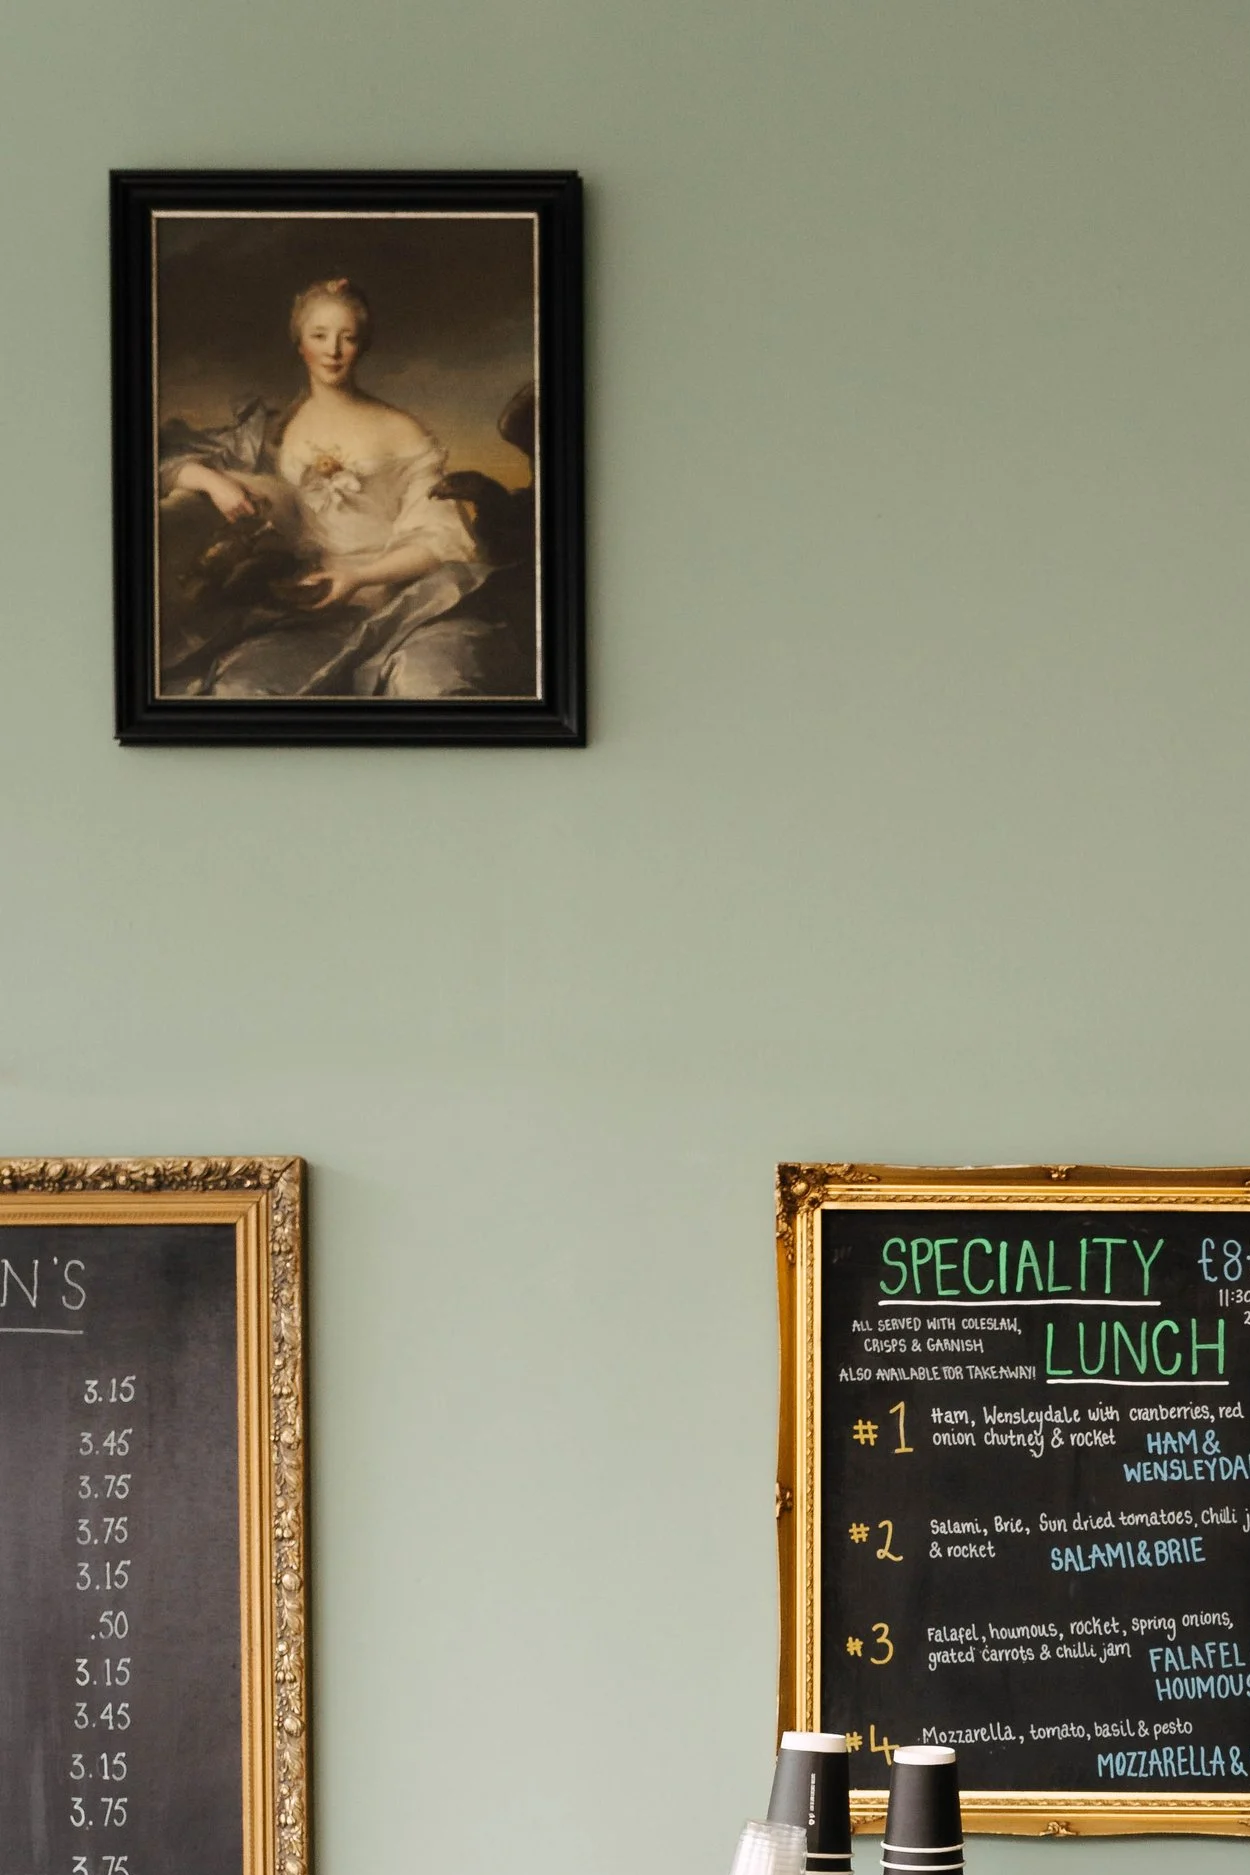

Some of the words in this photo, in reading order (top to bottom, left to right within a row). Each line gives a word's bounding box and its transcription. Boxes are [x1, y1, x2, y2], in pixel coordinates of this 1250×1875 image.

[879, 1238, 1164, 1295] SPECIALITY
[852, 1320, 872, 1332] ALL
[878, 1318, 921, 1332] SERVED
[927, 1318, 955, 1331] WITH
[864, 1338, 906, 1353] CRISPS
[911, 1339, 922, 1352] &
[926, 1338, 984, 1353] GARNISH
[1046, 1318, 1226, 1376] LUNCH
[839, 1368, 872, 1382] ALSO
[876, 1366, 938, 1381] AVAILABLE
[943, 1366, 963, 1380] FOR
[84, 1375, 136, 1403] 3.15
[983, 1404, 1081, 1436] Wensleydale
[1088, 1402, 1120, 1422] with
[1219, 1402, 1245, 1419] red
[79, 1428, 133, 1456] 3.45
[932, 1429, 976, 1447] onion
[984, 1428, 1044, 1458] chutney
[1051, 1429, 1064, 1448] &
[1070, 1428, 1116, 1447] rocket
[1147, 1429, 1198, 1455] HAM
[78, 1474, 131, 1500] 3.75
[76, 1517, 128, 1545] 3.75
[1039, 1513, 1067, 1533] Sun
[1072, 1511, 1114, 1531] dried
[929, 1541, 942, 1559] &
[947, 1541, 996, 1559] rocket
[76, 1560, 131, 1590] 3.15
[1132, 1616, 1176, 1641] spring
[928, 1646, 974, 1671] grated
[982, 1645, 1035, 1664] carrots
[1040, 1644, 1051, 1660] &
[1056, 1642, 1097, 1659] chilli
[1100, 1641, 1131, 1663] jam
[1149, 1643, 1246, 1673] FALAFEL
[75, 1657, 131, 1686] 3.15
[74, 1702, 131, 1730] 3.45
[1094, 1718, 1133, 1738] basil
[1137, 1720, 1150, 1738] &
[1153, 1718, 1193, 1741] pesto
[69, 1752, 128, 1782] 3.15
[1097, 1745, 1227, 1779] MOZZARELLA
[1230, 1749, 1249, 1774] &
[70, 1797, 128, 1828] 3.75
